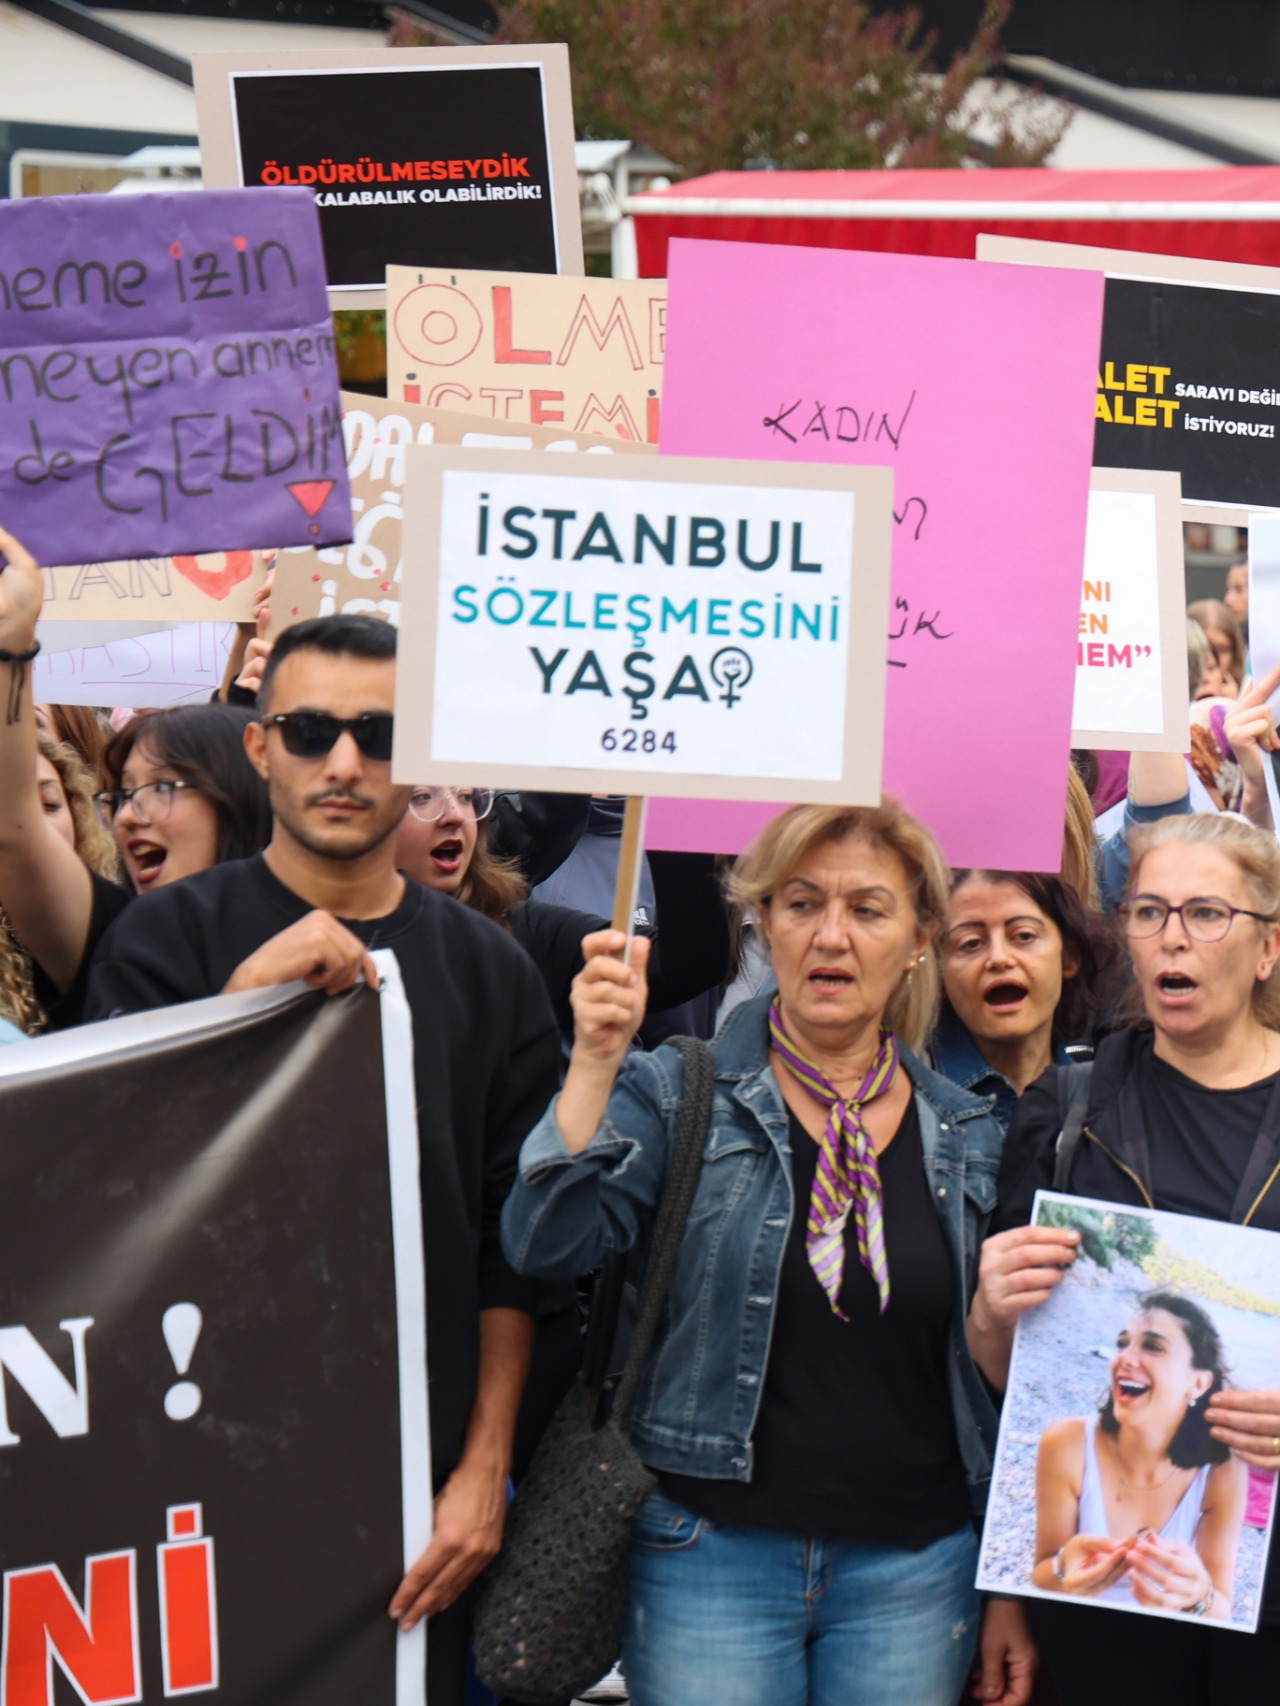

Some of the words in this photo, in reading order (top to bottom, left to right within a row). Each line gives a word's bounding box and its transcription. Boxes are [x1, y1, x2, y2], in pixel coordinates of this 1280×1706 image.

[261, 153, 530, 185] ÖLDÜRÜLMESEYDİK
[419, 182, 542, 203] OLABİLİRDİK!
[1175, 383, 1235, 401] SARAYI
[763, 390, 916, 451] KADIN
[1184, 413, 1275, 438] İSTİYORUZ!
[14, 419, 75, 485] de
[476, 492, 823, 573] İSTANBUL
[452, 576, 840, 648] SÖZLEŞMESİNİ
[601, 728, 677, 755] 6284
